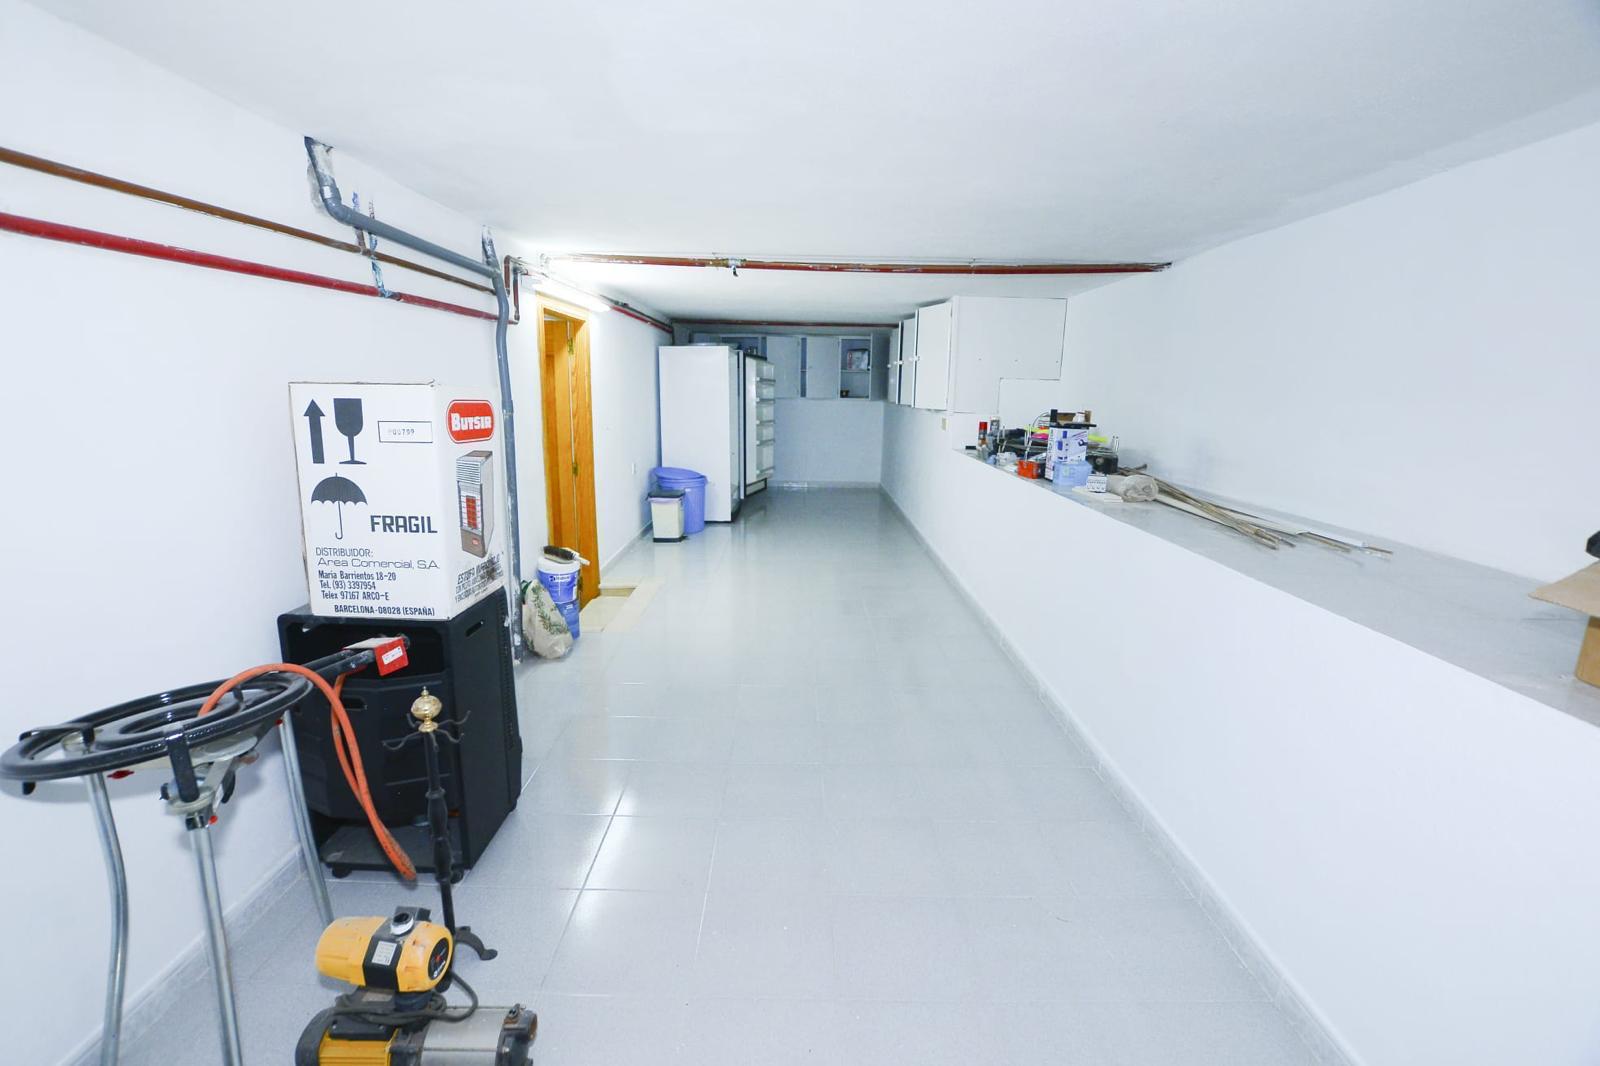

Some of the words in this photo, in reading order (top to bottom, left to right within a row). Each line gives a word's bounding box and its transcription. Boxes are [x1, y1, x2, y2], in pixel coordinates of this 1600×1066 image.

[370, 514, 438, 534] FRAGIL
[315, 547, 374, 558] DISTRIBUIDOR:
[317, 557, 348, 567] Area
[351, 558, 414, 570] Comercial,
[339, 570, 375, 580] Barrientos
[376, 572, 397, 581] 18-20
[332, 580, 347, 590] (93)
[347, 580, 376, 590] 3397954
[321, 590, 338, 599] Telex
[339, 591, 360, 600] 97167
[362, 591, 390, 601] ARCO-E
[402, 606, 435, 616] (ESPAÑA)
